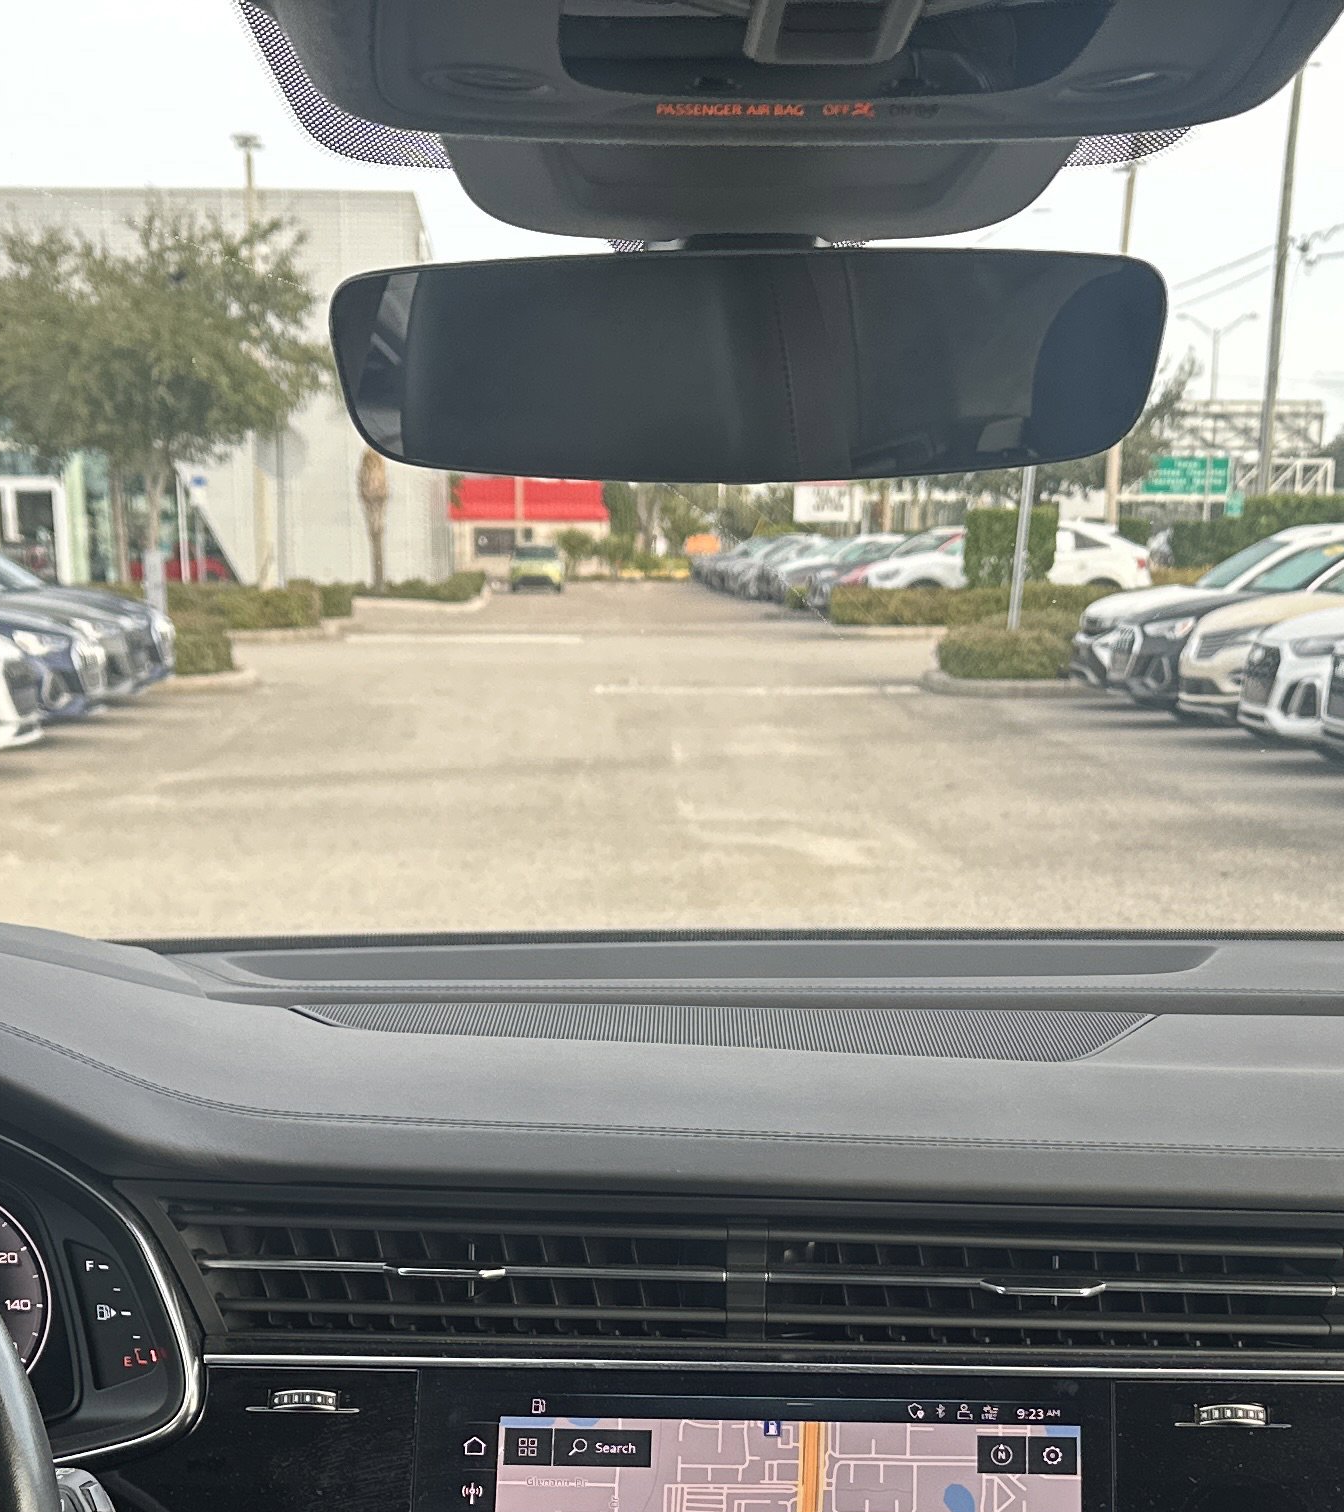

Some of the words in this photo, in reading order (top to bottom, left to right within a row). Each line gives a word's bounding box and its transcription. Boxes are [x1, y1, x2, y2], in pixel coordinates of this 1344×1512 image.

[656, 103, 742, 116] PASSENGER
[746, 104, 770, 116] AIR
[773, 104, 804, 116] BAG
[85, 1261, 94, 1271] F
[5, 1299, 31, 1311] 140
[124, 1356, 132, 1367] E
[1016, 1408, 1044, 1420] 9:23
[1046, 1409, 1061, 1417] AM
[595, 1443, 636, 1454] Search
